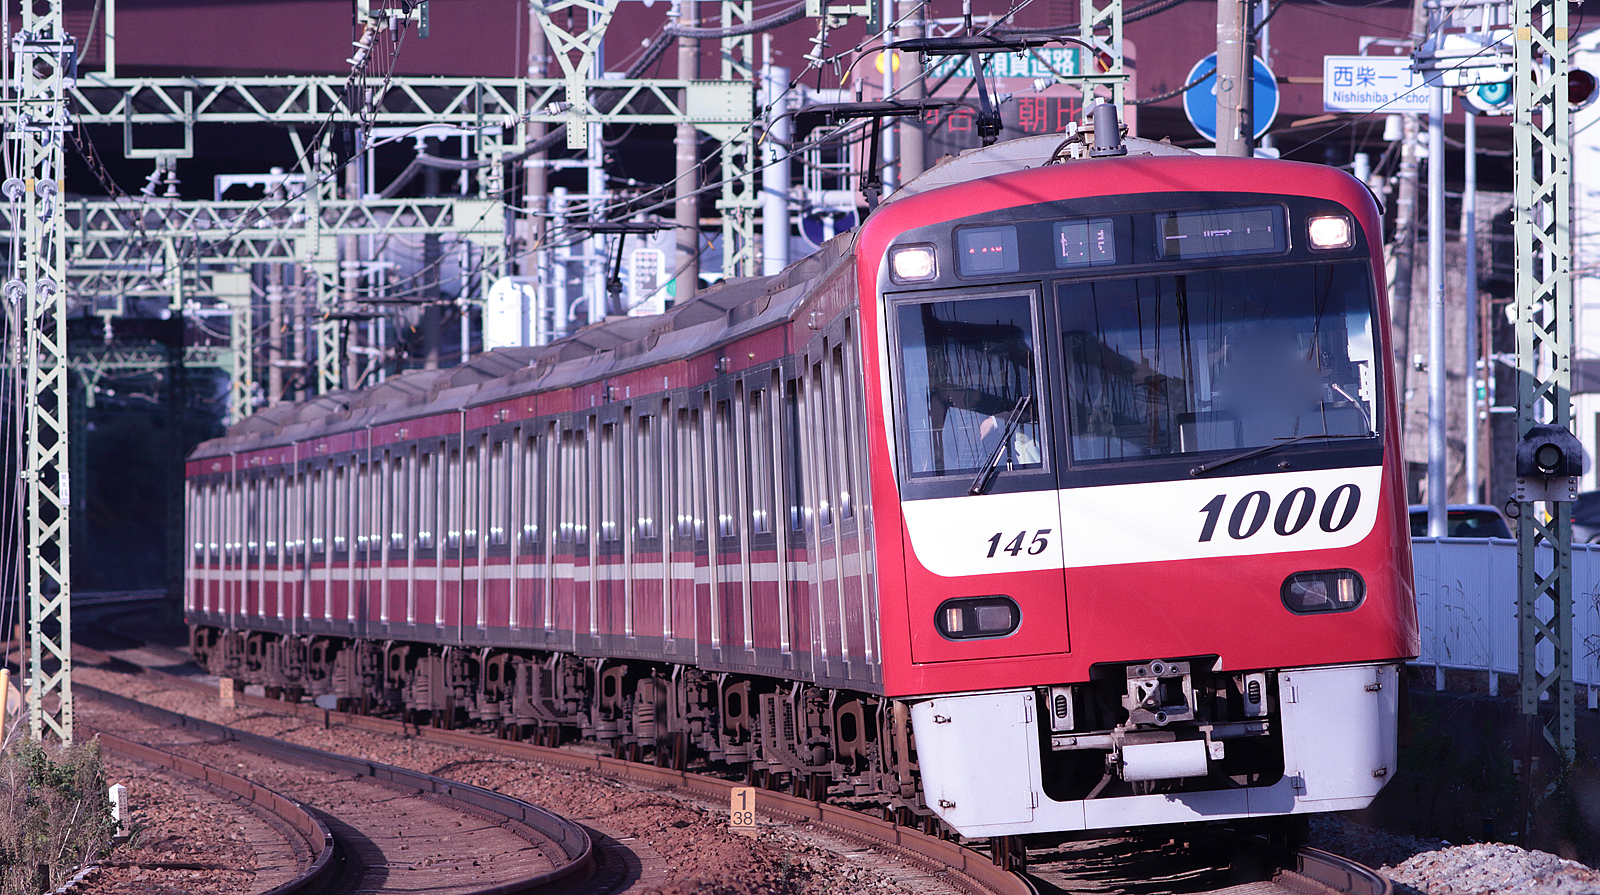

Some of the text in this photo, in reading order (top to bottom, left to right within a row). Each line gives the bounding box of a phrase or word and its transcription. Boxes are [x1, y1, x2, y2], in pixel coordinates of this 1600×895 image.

[1334, 66, 1429, 88] 西柴一丁
[1333, 91, 1388, 103] Nishishiba
[1198, 483, 1362, 543] 1000
[986, 528, 1052, 559] 145
[737, 790, 747, 811] 1
[733, 811, 753, 826] 38
